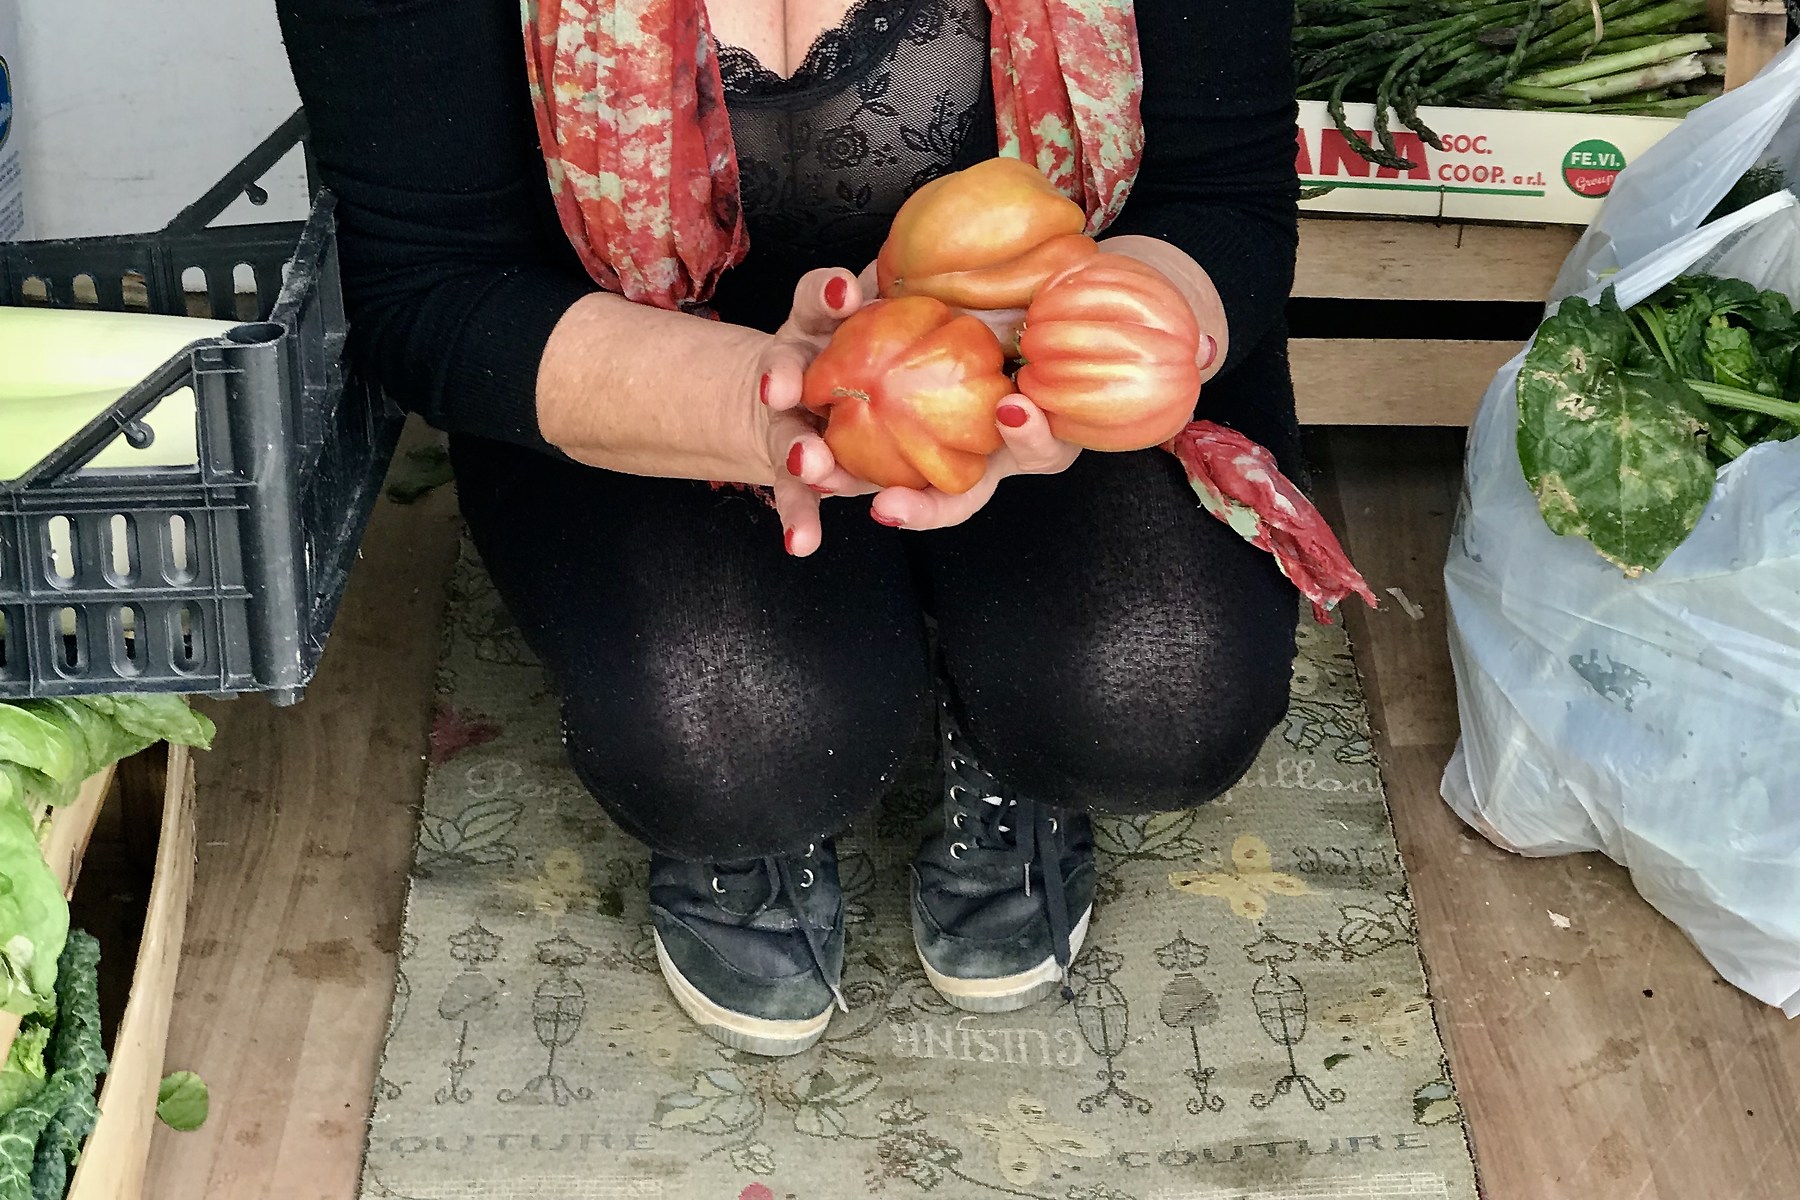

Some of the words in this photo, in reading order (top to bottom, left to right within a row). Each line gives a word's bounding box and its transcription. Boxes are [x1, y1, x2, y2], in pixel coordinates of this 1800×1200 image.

[1296, 127, 1432, 181] NA
[1441, 133, 1493, 155] SOC.
[1570, 151, 1621, 168] FE.VI.
[1438, 163, 1507, 185] COOP.
[1575, 175, 1616, 192] Group
[1117, 1132, 1430, 1168] COUTURE
